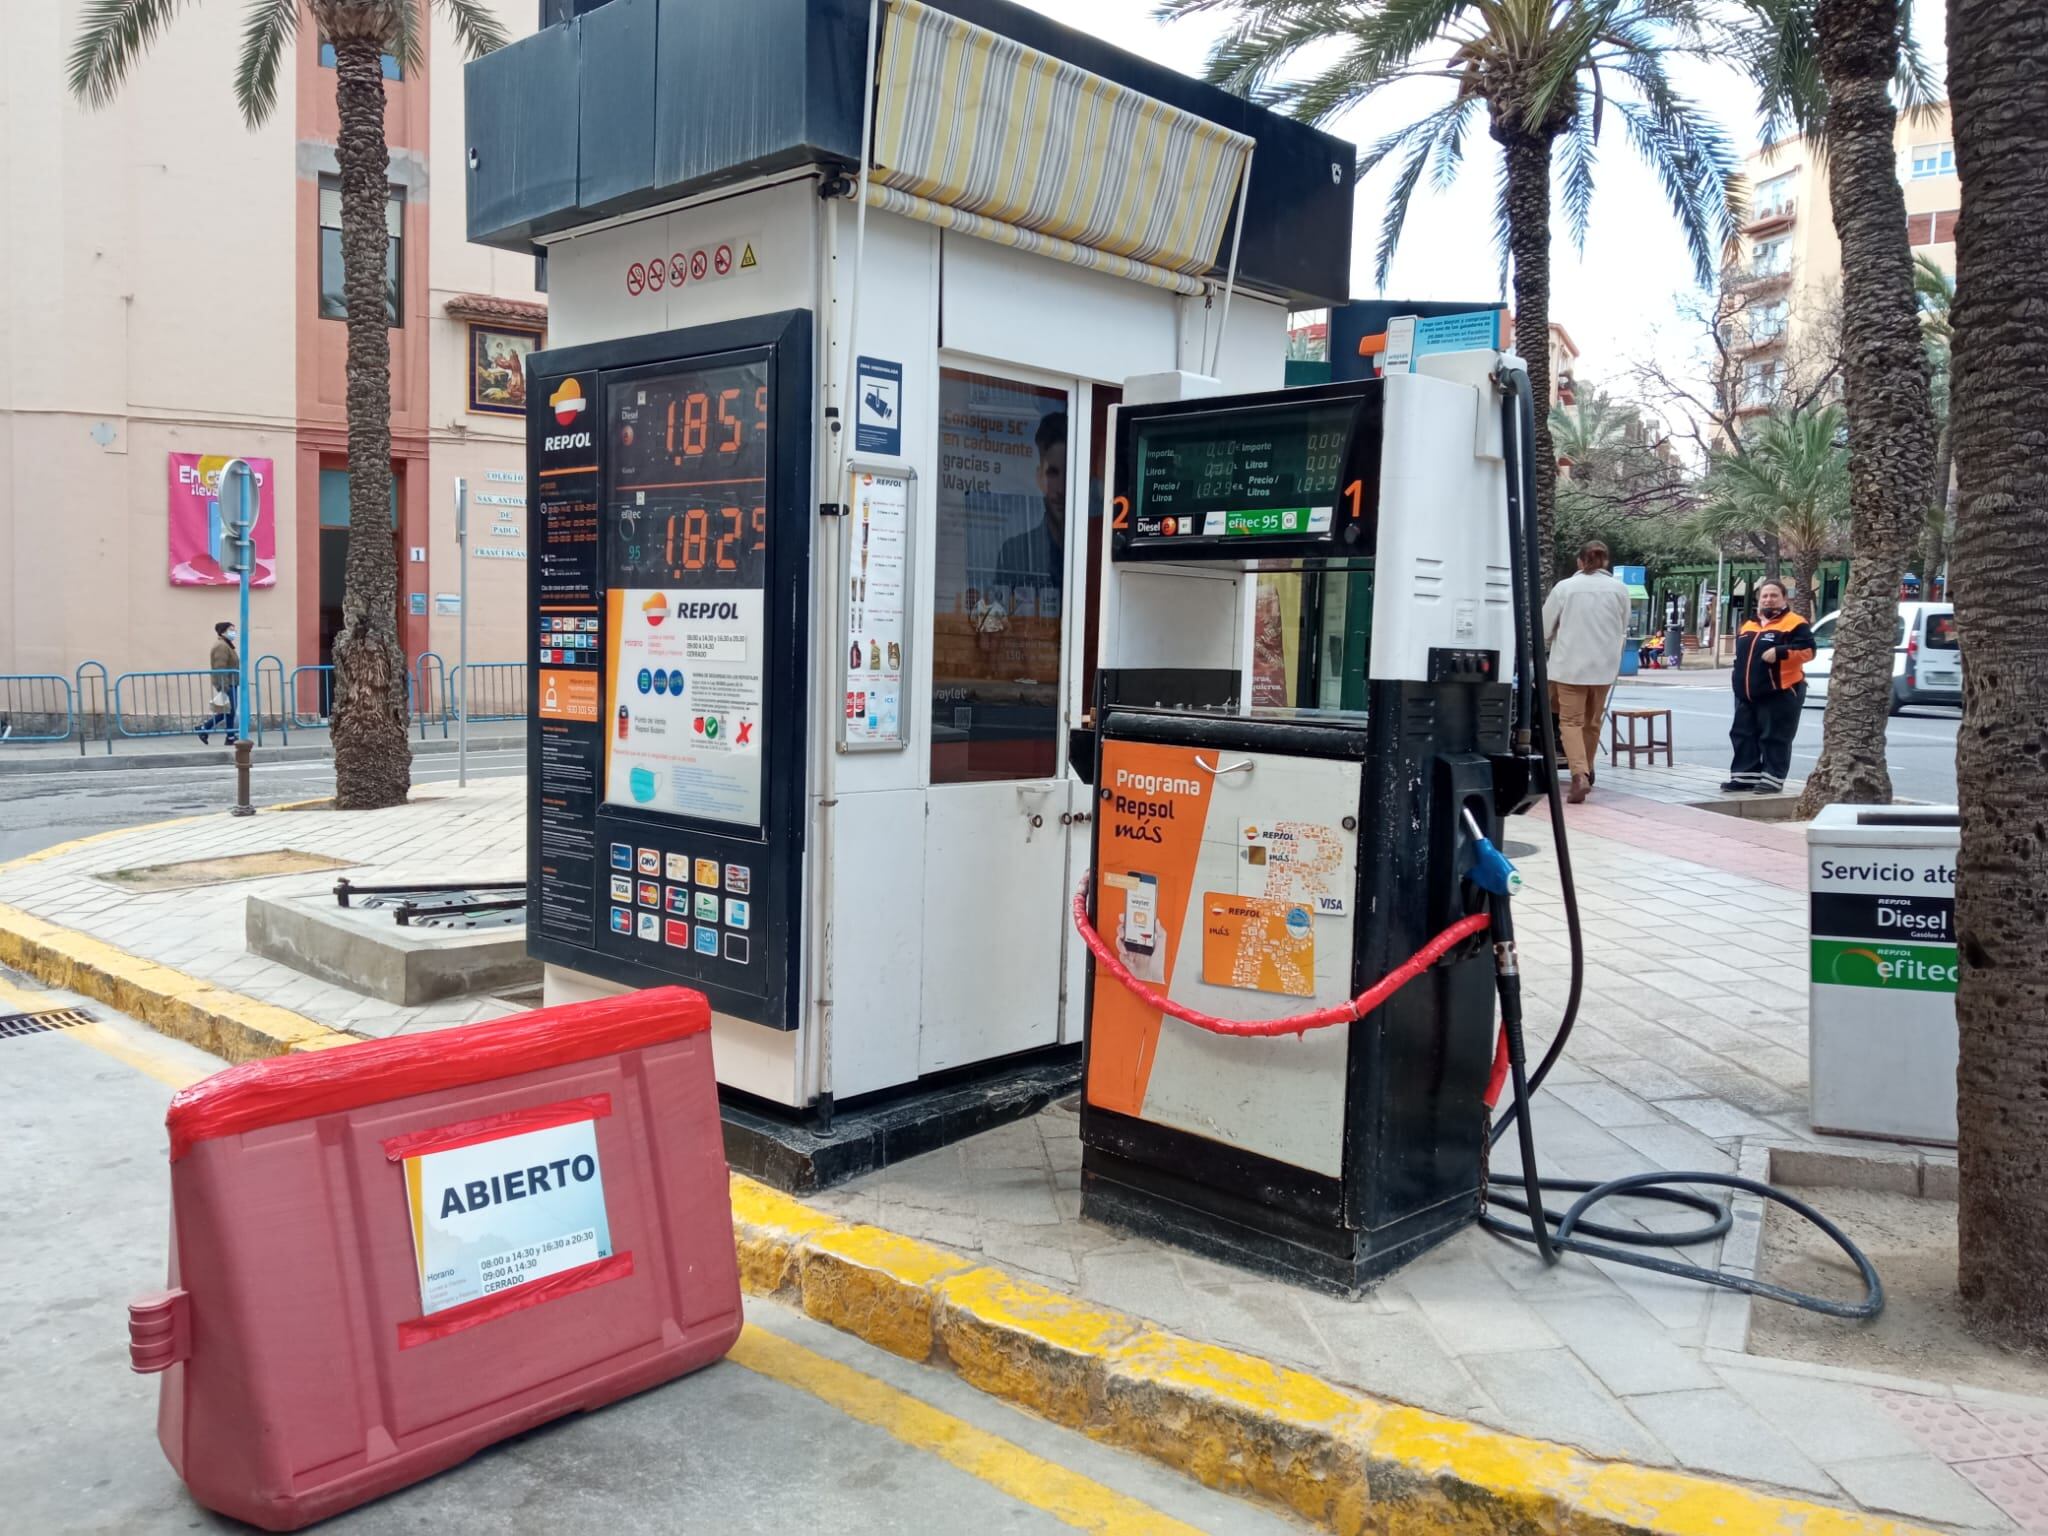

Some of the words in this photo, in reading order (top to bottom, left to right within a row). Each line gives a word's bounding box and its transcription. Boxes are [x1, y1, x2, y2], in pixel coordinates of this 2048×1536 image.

[544, 432, 592, 452] REPSOL
[963, 435, 1032, 458] carburante
[1242, 442, 1272, 452] Importe
[943, 453, 990, 473] gracias
[1245, 460, 1268, 470] Litros
[180, 465, 202, 484] En
[942, 472, 992, 496] Waylet
[1152, 494, 1172, 502] Litros
[1247, 488, 1270, 496] Litros
[1344, 480, 1365, 518] 1
[1111, 496, 1130, 530] 2
[1228, 518, 1260, 528] efitec
[1262, 515, 1278, 528] 95
[1137, 521, 1160, 532] Diesel
[415, 550, 420, 561] 1
[628, 545, 641, 560] 95
[677, 602, 739, 620] REPSOL
[1116, 769, 1200, 796] Programa
[1116, 796, 1174, 820] Repsol
[1114, 820, 1162, 844] más
[1262, 830, 1294, 841] REPSOL
[641, 857, 656, 867] DKV
[1820, 861, 1914, 882] Servicio
[1320, 897, 1344, 911] VISA
[1878, 898, 1912, 906] REPSOL
[1228, 907, 1260, 918] REPSOL
[1877, 908, 1947, 930] Diesel
[1876, 948, 1911, 956] REPSOL
[1876, 959, 1958, 982] efitec
[440, 1154, 596, 1220] ABIERTO
[480, 1256, 504, 1270] 08:00
[504, 1256, 511, 1264] a
[512, 1248, 535, 1262] 14:30
[536, 1248, 540, 1257] y
[541, 1240, 564, 1254] 16:30
[565, 1238, 571, 1246] a
[572, 1231, 594, 1245] 20:30
[482, 1268, 506, 1282] 09:00
[507, 1266, 514, 1276] A
[514, 1258, 538, 1273] 14:30
[484, 1274, 525, 1294] CERRADO
